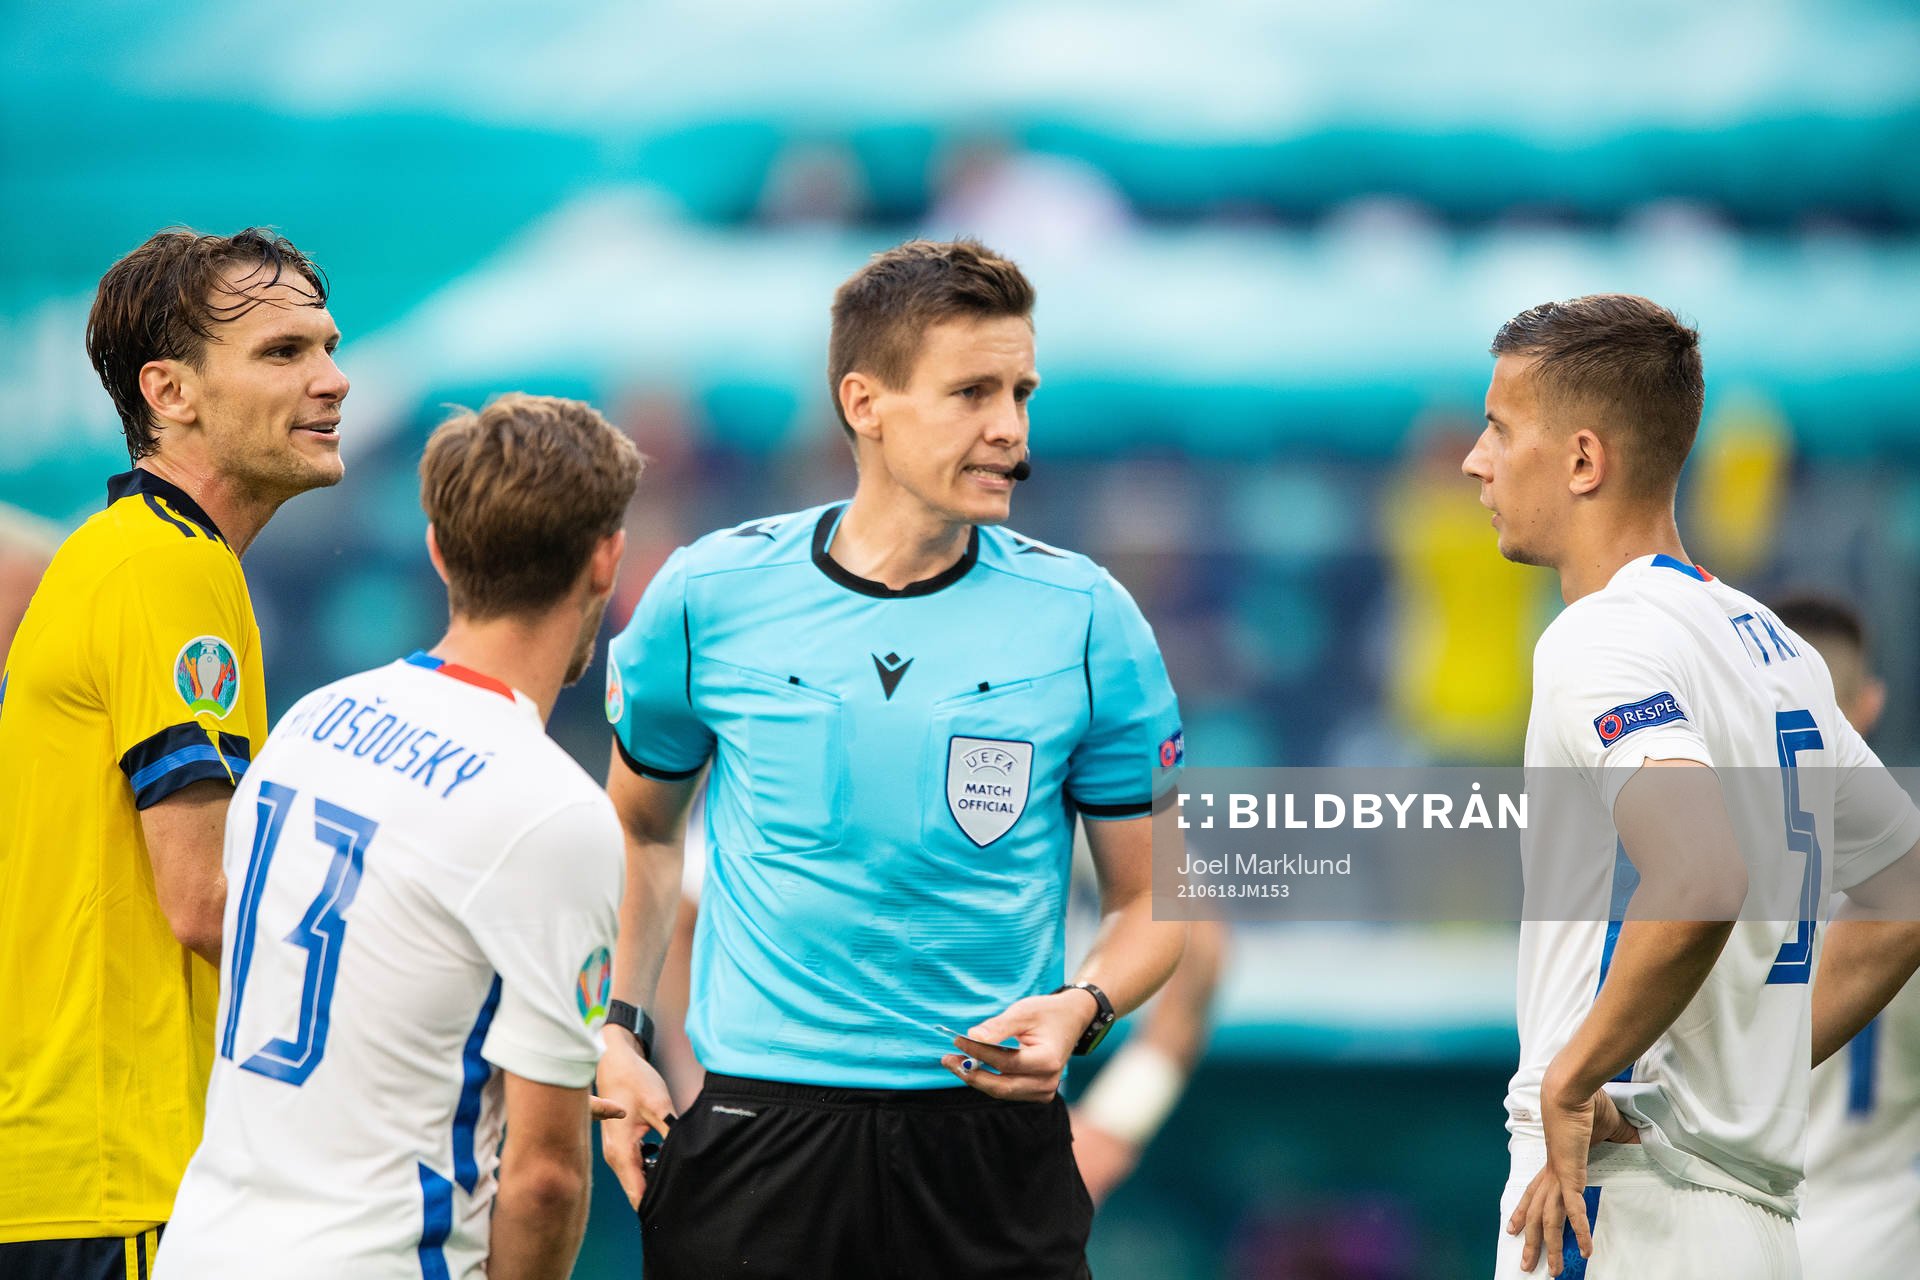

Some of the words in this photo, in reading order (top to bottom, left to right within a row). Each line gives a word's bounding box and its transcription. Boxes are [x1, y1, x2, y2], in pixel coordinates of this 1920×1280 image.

[966, 752, 1014, 772] UEFA
[965, 783, 1012, 798] MATCH
[958, 798, 1015, 814] OFFICIAL
[1765, 709, 1825, 985] 5
[221, 780, 380, 1087] 13
